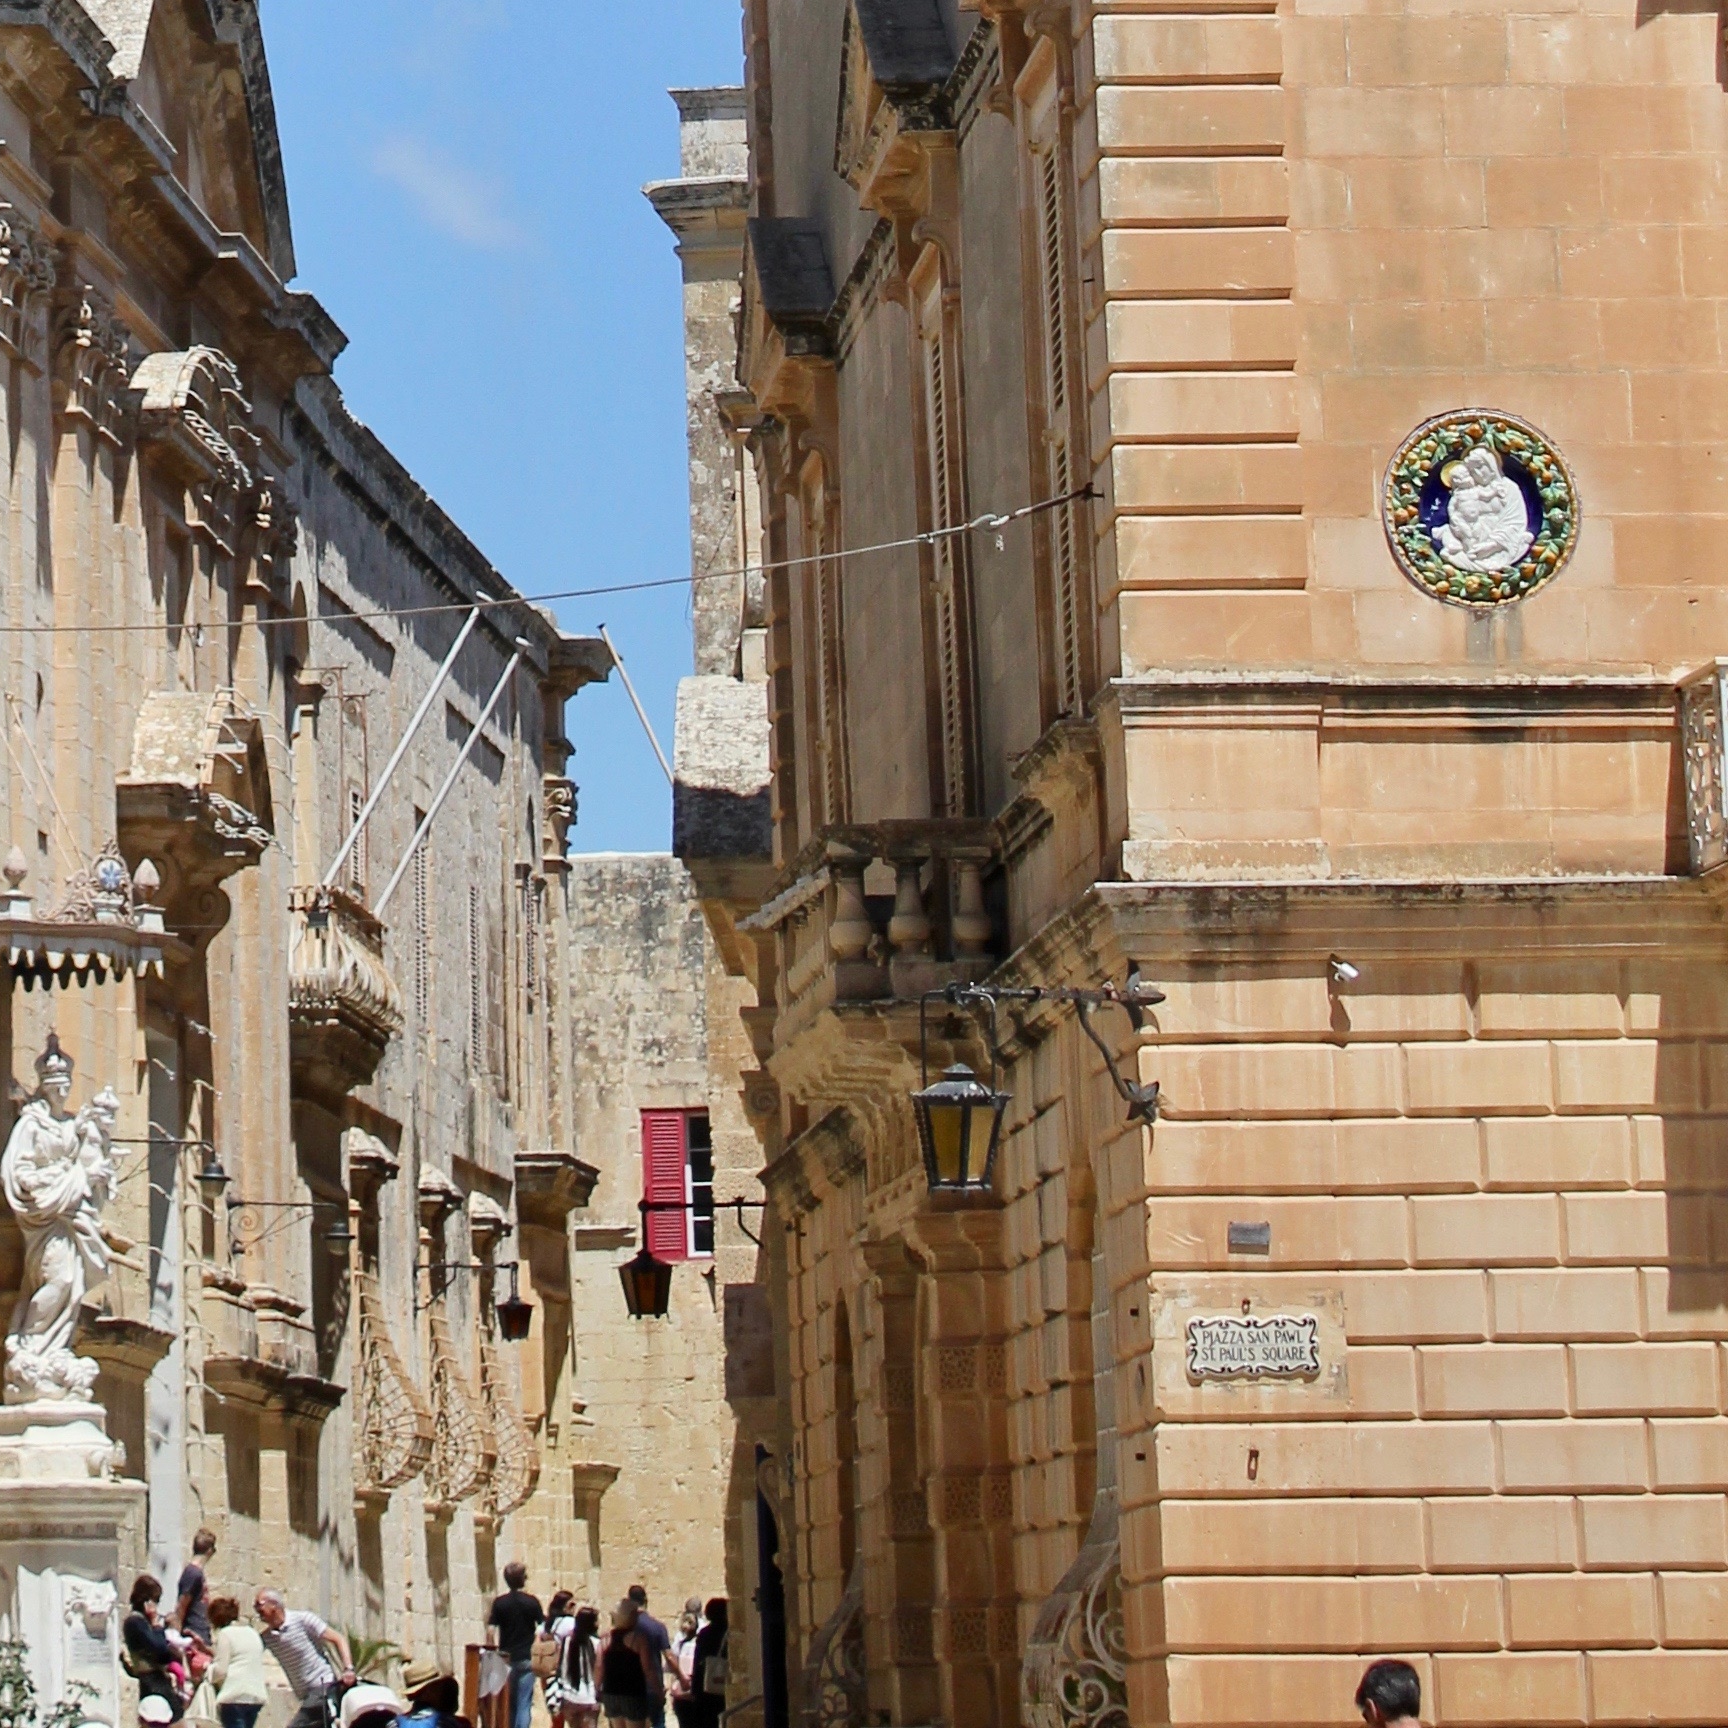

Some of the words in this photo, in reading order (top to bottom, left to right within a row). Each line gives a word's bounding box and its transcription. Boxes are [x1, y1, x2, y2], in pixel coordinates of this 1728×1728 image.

[1247, 1330, 1270, 1344] SAN
[1274, 1330, 1303, 1344] PAWL
[1219, 1346, 1256, 1362] PAUL'S
[1262, 1346, 1307, 1362] SQUARE
